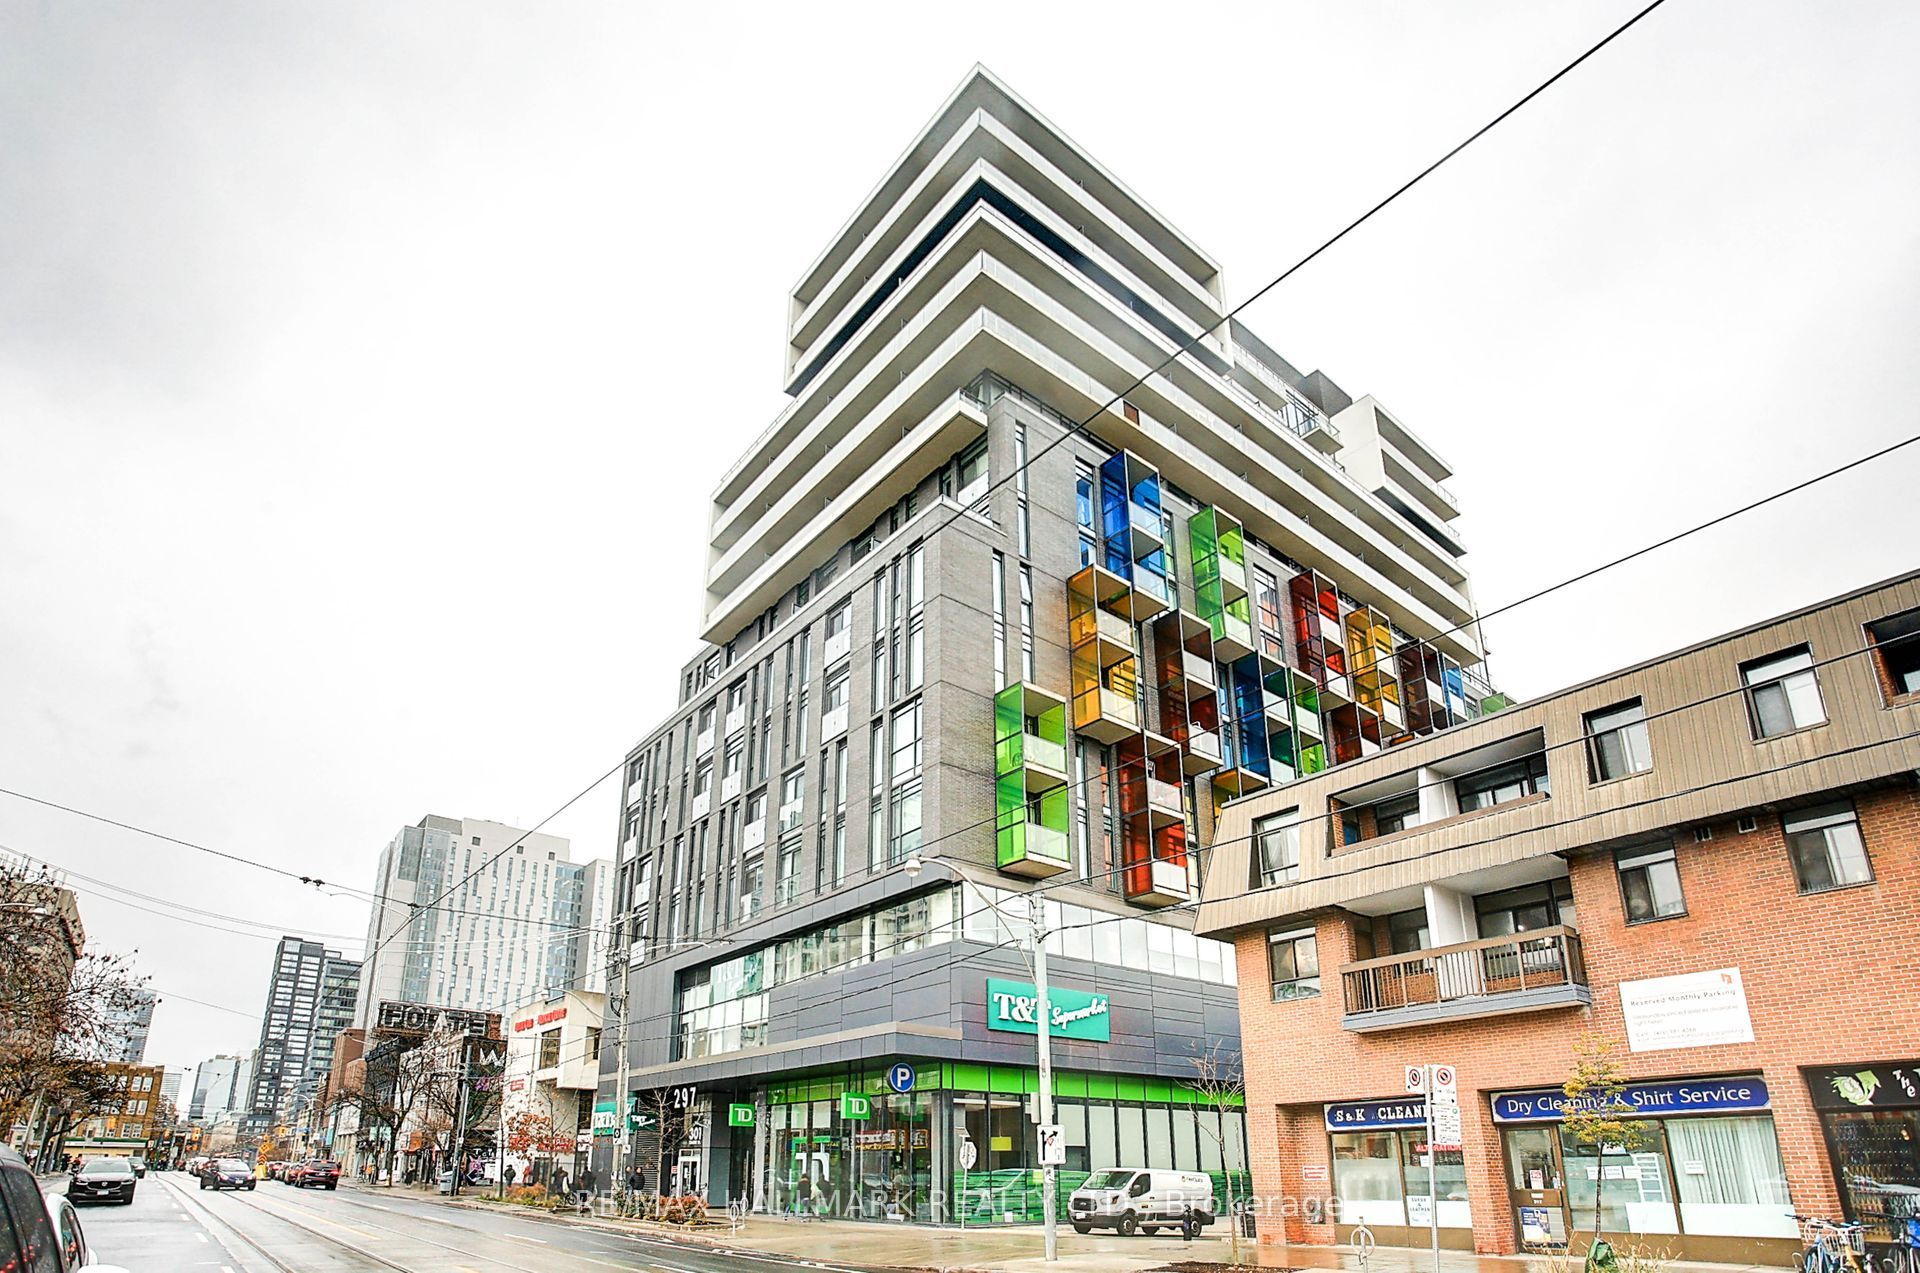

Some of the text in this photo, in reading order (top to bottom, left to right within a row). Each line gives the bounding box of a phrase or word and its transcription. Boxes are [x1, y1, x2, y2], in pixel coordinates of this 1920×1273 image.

[1630, 989, 1736, 1006] Reserved Monthly Parking
[896, 1067, 910, 1088] P
[1892, 1069, 1916, 1098] The
[674, 1086, 697, 1109] 297
[848, 1097, 868, 1114] TD
[1507, 1099, 1533, 1116] Dry
[1614, 1093, 1629, 1106] &
[1632, 1090, 1674, 1107] Shirt
[1679, 1087, 1751, 1103] Service
[734, 1107, 753, 1122] TD
[1378, 1104, 1427, 1120] CLEAN
[688, 1126, 702, 1140] 301
